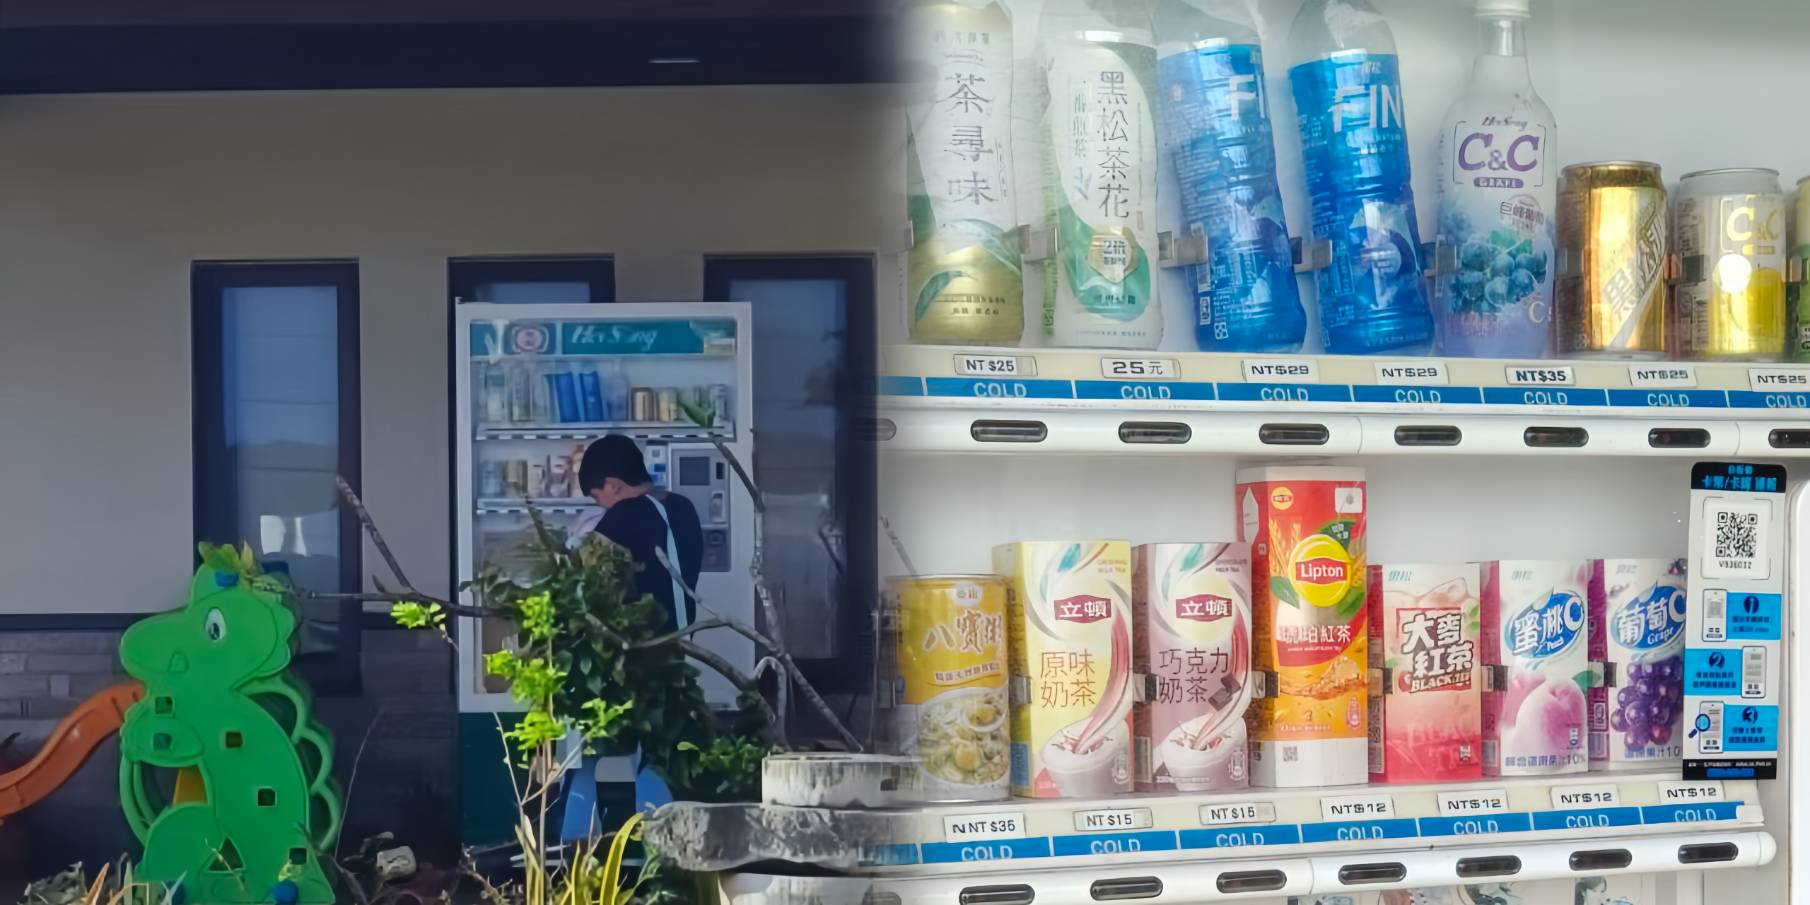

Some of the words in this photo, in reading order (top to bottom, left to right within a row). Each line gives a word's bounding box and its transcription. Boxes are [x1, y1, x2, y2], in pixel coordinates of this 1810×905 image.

[1097, 71, 1129, 218] 黑松茶花
[1458, 132, 1540, 171] C&C
[966, 360, 984, 371] NT
[988, 361, 1015, 373] $25
[1252, 365, 1309, 375] NT$29
[1382, 367, 1438, 378] NT$29
[1516, 370, 1566, 382] NT$35
[1637, 370, 1688, 381] NT$25
[1757, 374, 1808, 385] NT$25
[974, 383, 1027, 397] COLD
[1121, 385, 1171, 400] COLD
[1261, 387, 1309, 401] COLD
[1395, 389, 1441, 403] COLD
[1524, 391, 1568, 405] COLD
[1647, 393, 1690, 407] COLD
[1766, 395, 1808, 408] COLD
[1301, 564, 1343, 580] Lipton
[1060, 601, 1108, 618] 立頓
[1181, 600, 1229, 616] 立頓
[1041, 649, 1096, 679] 原味
[1158, 647, 1229, 674] 巧克力
[1412, 641, 1474, 677] 紅茶
[1041, 679, 1096, 708] 奶茶
[1160, 676, 1208, 704] 奶茶
[1561, 792, 1612, 804] NT$12
[1667, 787, 1717, 799] NT$12
[1331, 803, 1386, 815] NT$12
[1447, 798, 1501, 811] NT$12
[1087, 815, 1104, 827] NT
[1106, 813, 1132, 827] $15
[1566, 814, 1609, 828] COLD
[1675, 808, 1716, 821] COLD
[1337, 826, 1383, 841] COLD
[1453, 820, 1498, 834] COLD
[1091, 838, 1140, 854] COLD
[1216, 832, 1264, 847] COLD
[961, 845, 1012, 861] COLD
